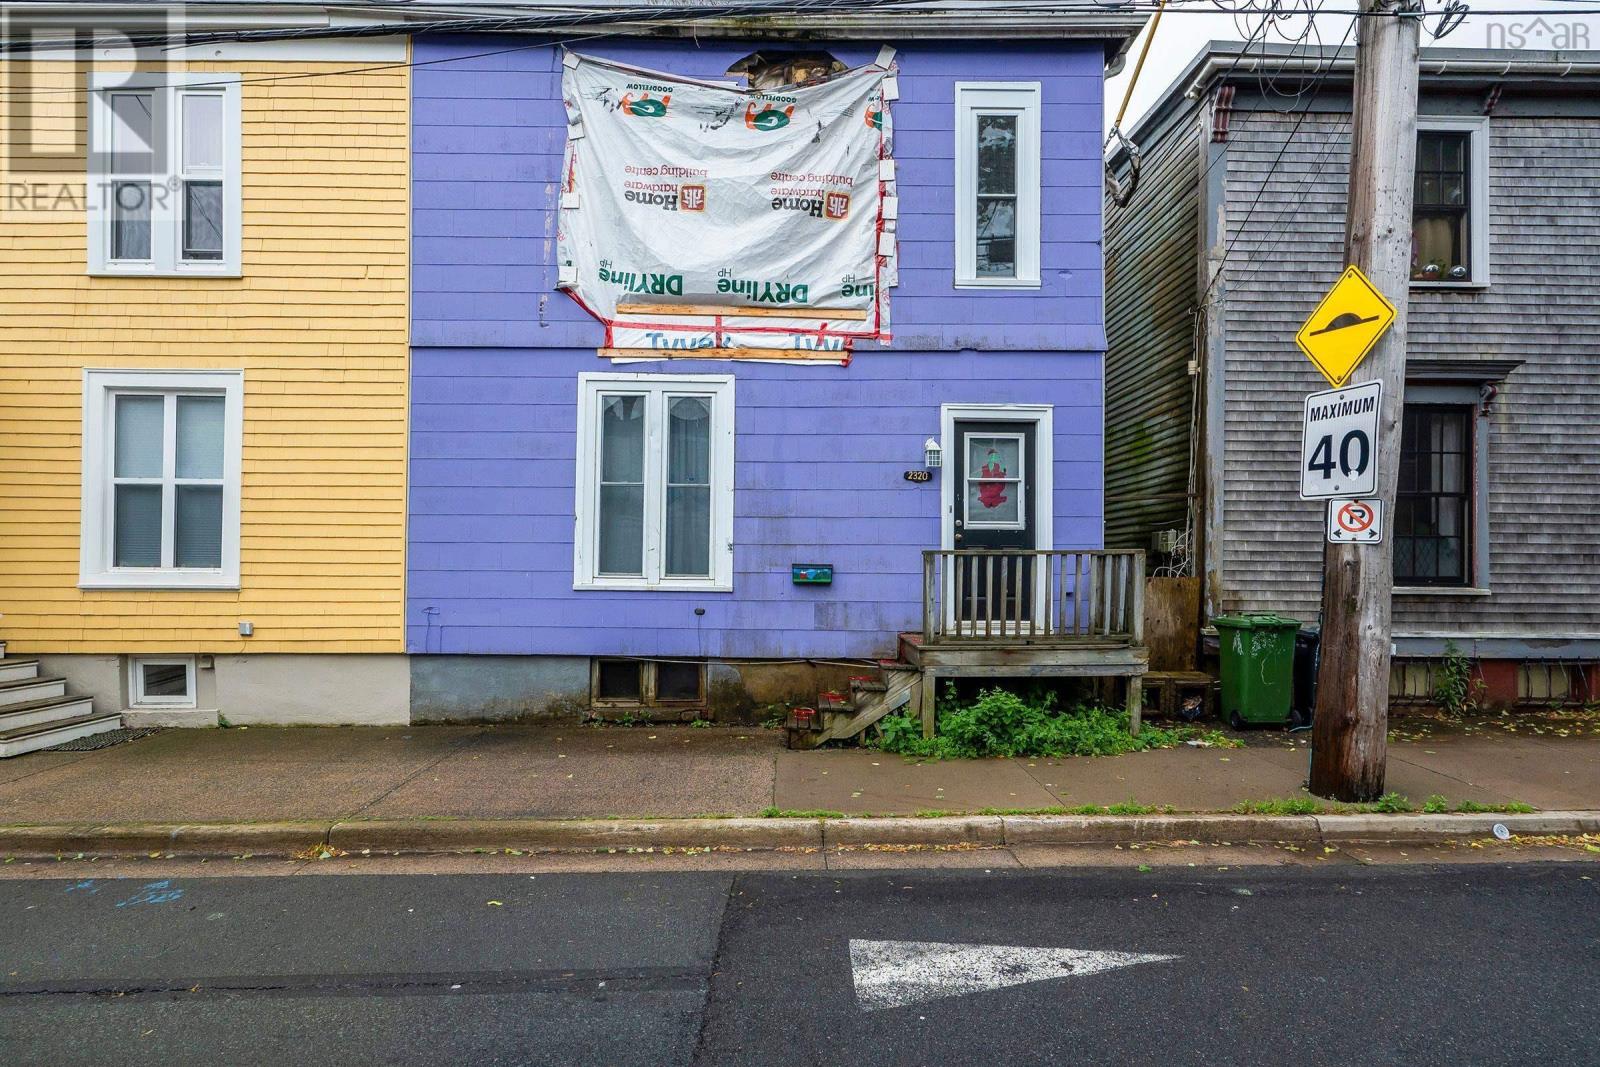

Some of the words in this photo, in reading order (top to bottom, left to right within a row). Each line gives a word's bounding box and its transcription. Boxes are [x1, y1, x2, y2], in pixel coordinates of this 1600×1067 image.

[626, 83, 673, 93] GOODFELLOW
[624, 165, 659, 176] centre
[660, 164, 708, 178] building
[770, 172, 806, 183] centre
[808, 173, 854, 187] building
[623, 181, 678, 194] hardware
[770, 188, 824, 200] hardware
[624, 190, 678, 211] Home
[771, 197, 824, 218] Home
[600, 259, 613, 269] HP
[717, 268, 732, 277] HP
[841, 274, 856, 283] HP
[598, 267, 683, 296] DRYline
[716, 278, 809, 303] DRYline
[1310, 396, 1375, 422] MAXIMUM
[1308, 429, 1370, 480] 40
[907, 471, 929, 480] 2320
